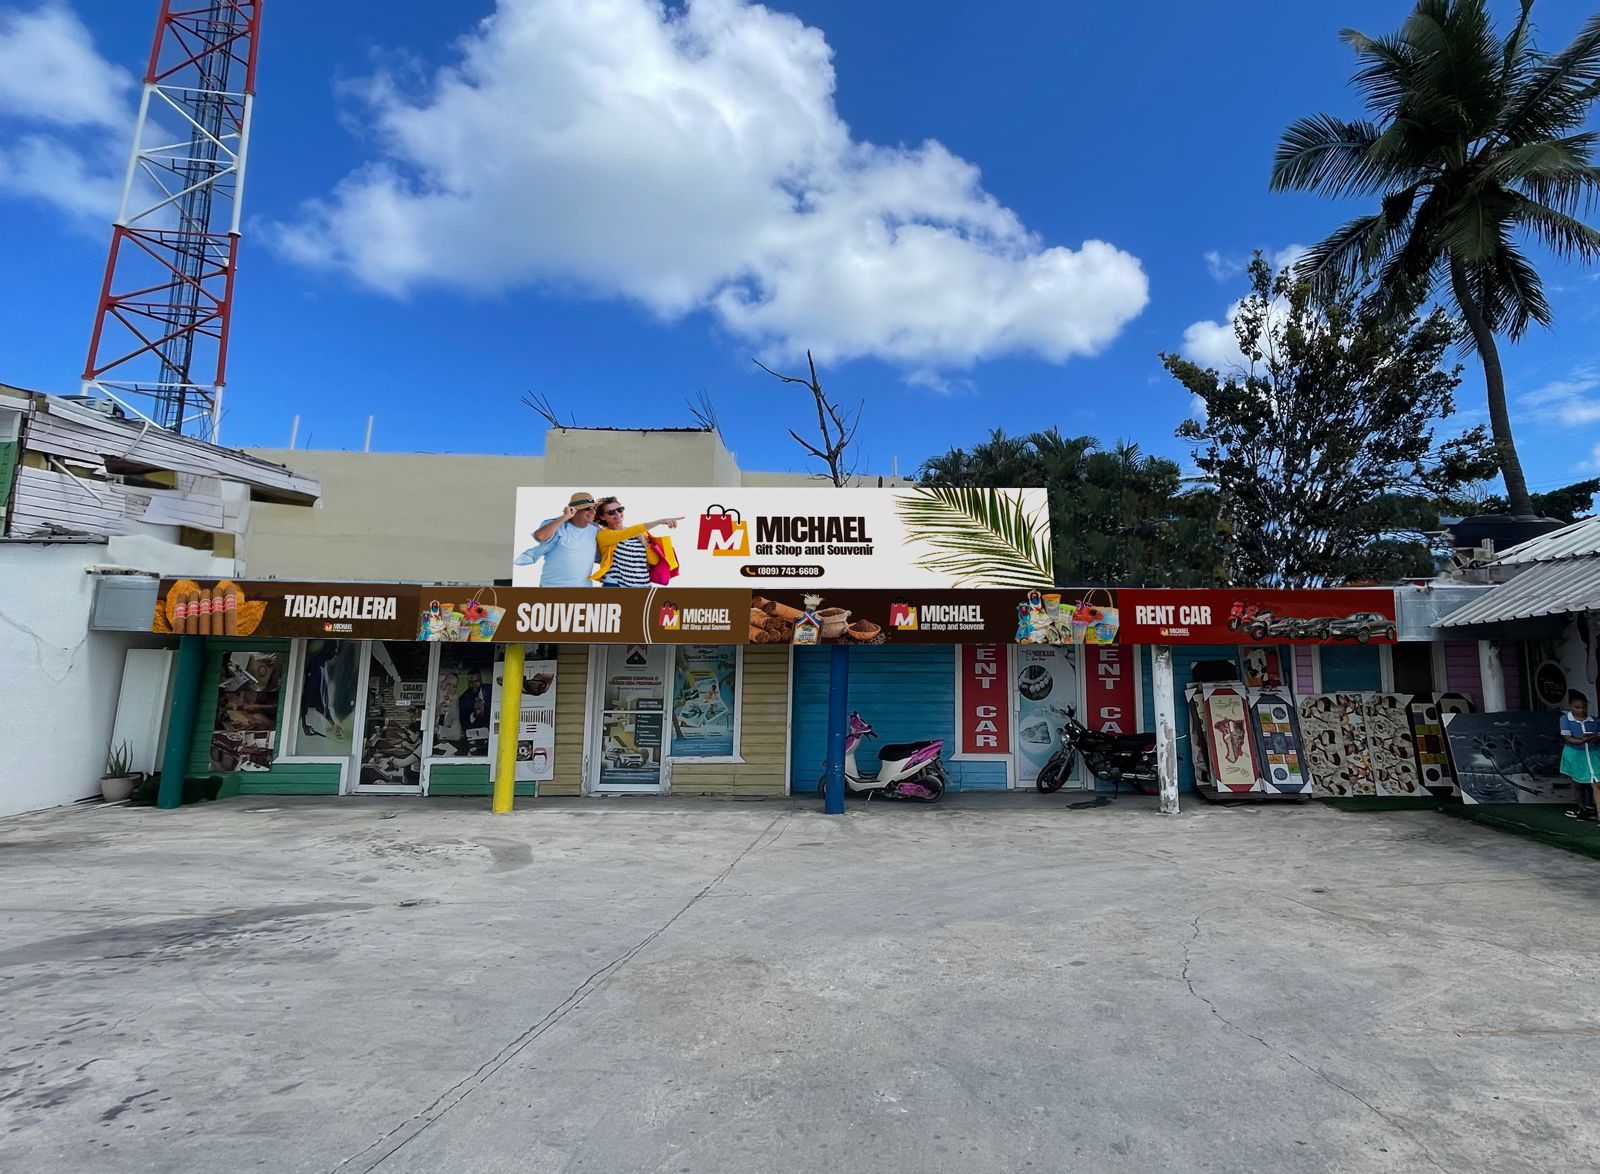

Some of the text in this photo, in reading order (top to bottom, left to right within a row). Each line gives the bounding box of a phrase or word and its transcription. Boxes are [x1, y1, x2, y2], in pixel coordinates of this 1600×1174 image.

[756, 516, 872, 543] MICHAEL
[755, 544, 874, 557] Gift Shop and Souvenir
[758, 566, 819, 576] (809) 743-6608
[284, 594, 397, 620] TABACALERA
[921, 605, 984, 623] MICHAEL
[1135, 605, 1212, 625] RENT CAR
[516, 602, 622, 634] SOUVENIR
[682, 608, 731, 624] MICHAEL
[690, 624, 701, 632] Shop
[931, 623, 946, 632] Shop
[400, 692, 424, 700] FACTORY
[402, 683, 423, 692] CIGARS
[975, 643, 998, 747] ENT CAR
[1098, 643, 1123, 734] ENT CA
